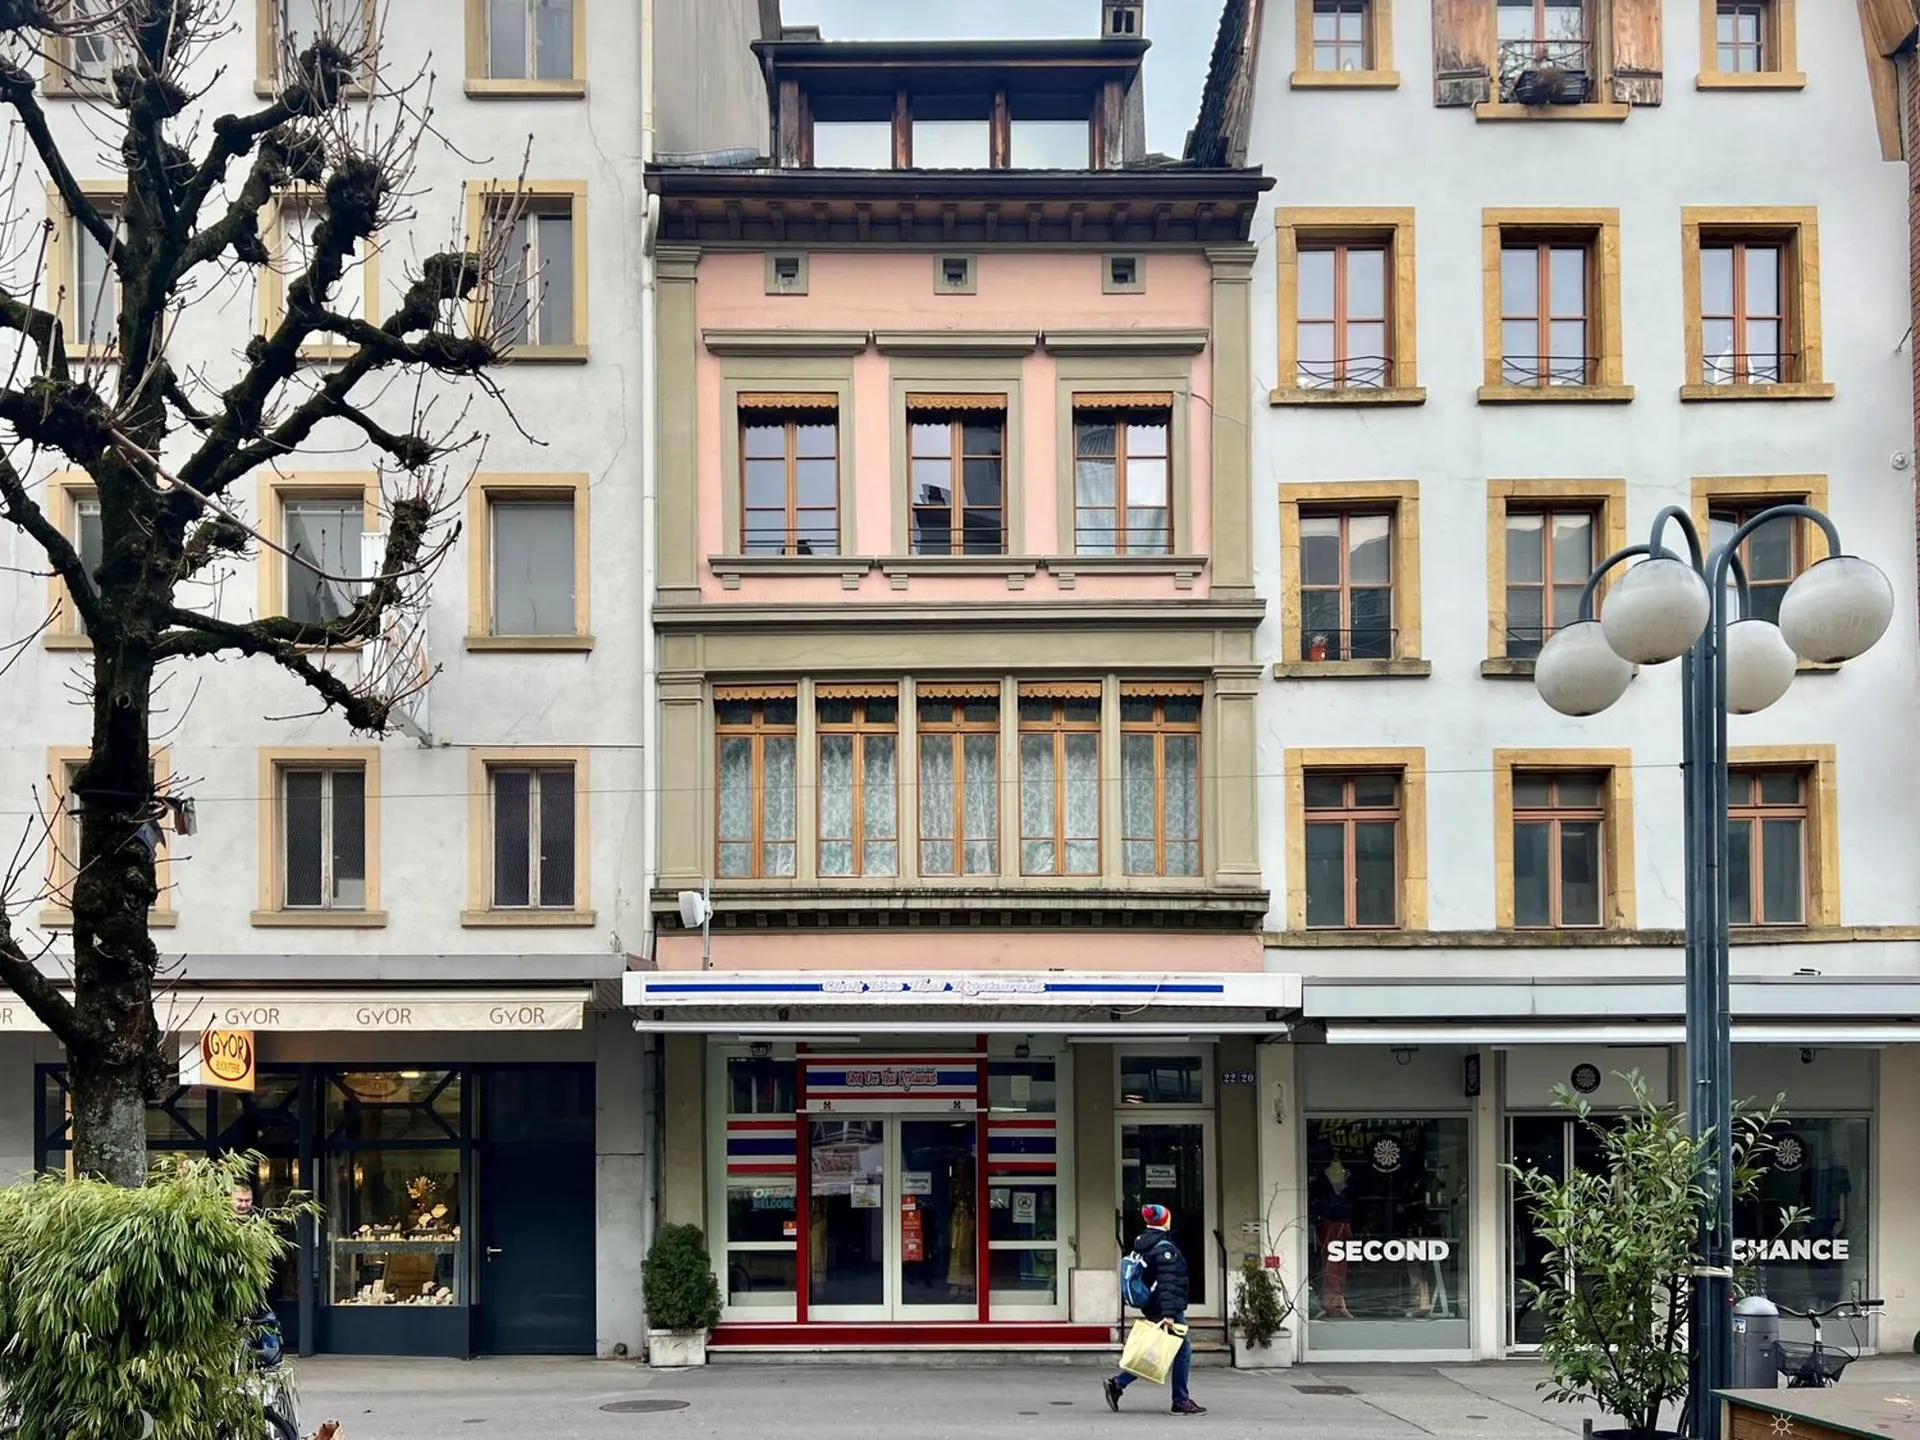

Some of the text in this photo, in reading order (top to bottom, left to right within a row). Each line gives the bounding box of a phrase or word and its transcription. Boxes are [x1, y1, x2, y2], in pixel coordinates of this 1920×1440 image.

[225, 1007, 280, 1025] GYOR
[356, 1007, 412, 1025] GYOR
[489, 1007, 545, 1025] GYOR
[210, 1030, 244, 1060] GYOR
[1223, 1073, 1237, 1084] 22
[1240, 1073, 1255, 1084] 20
[752, 1188, 797, 1199] OPEN
[752, 1198, 797, 1210] WELCOME
[1327, 1240, 1450, 1262] SECOND
[1732, 1239, 1850, 1261] CHANCE
